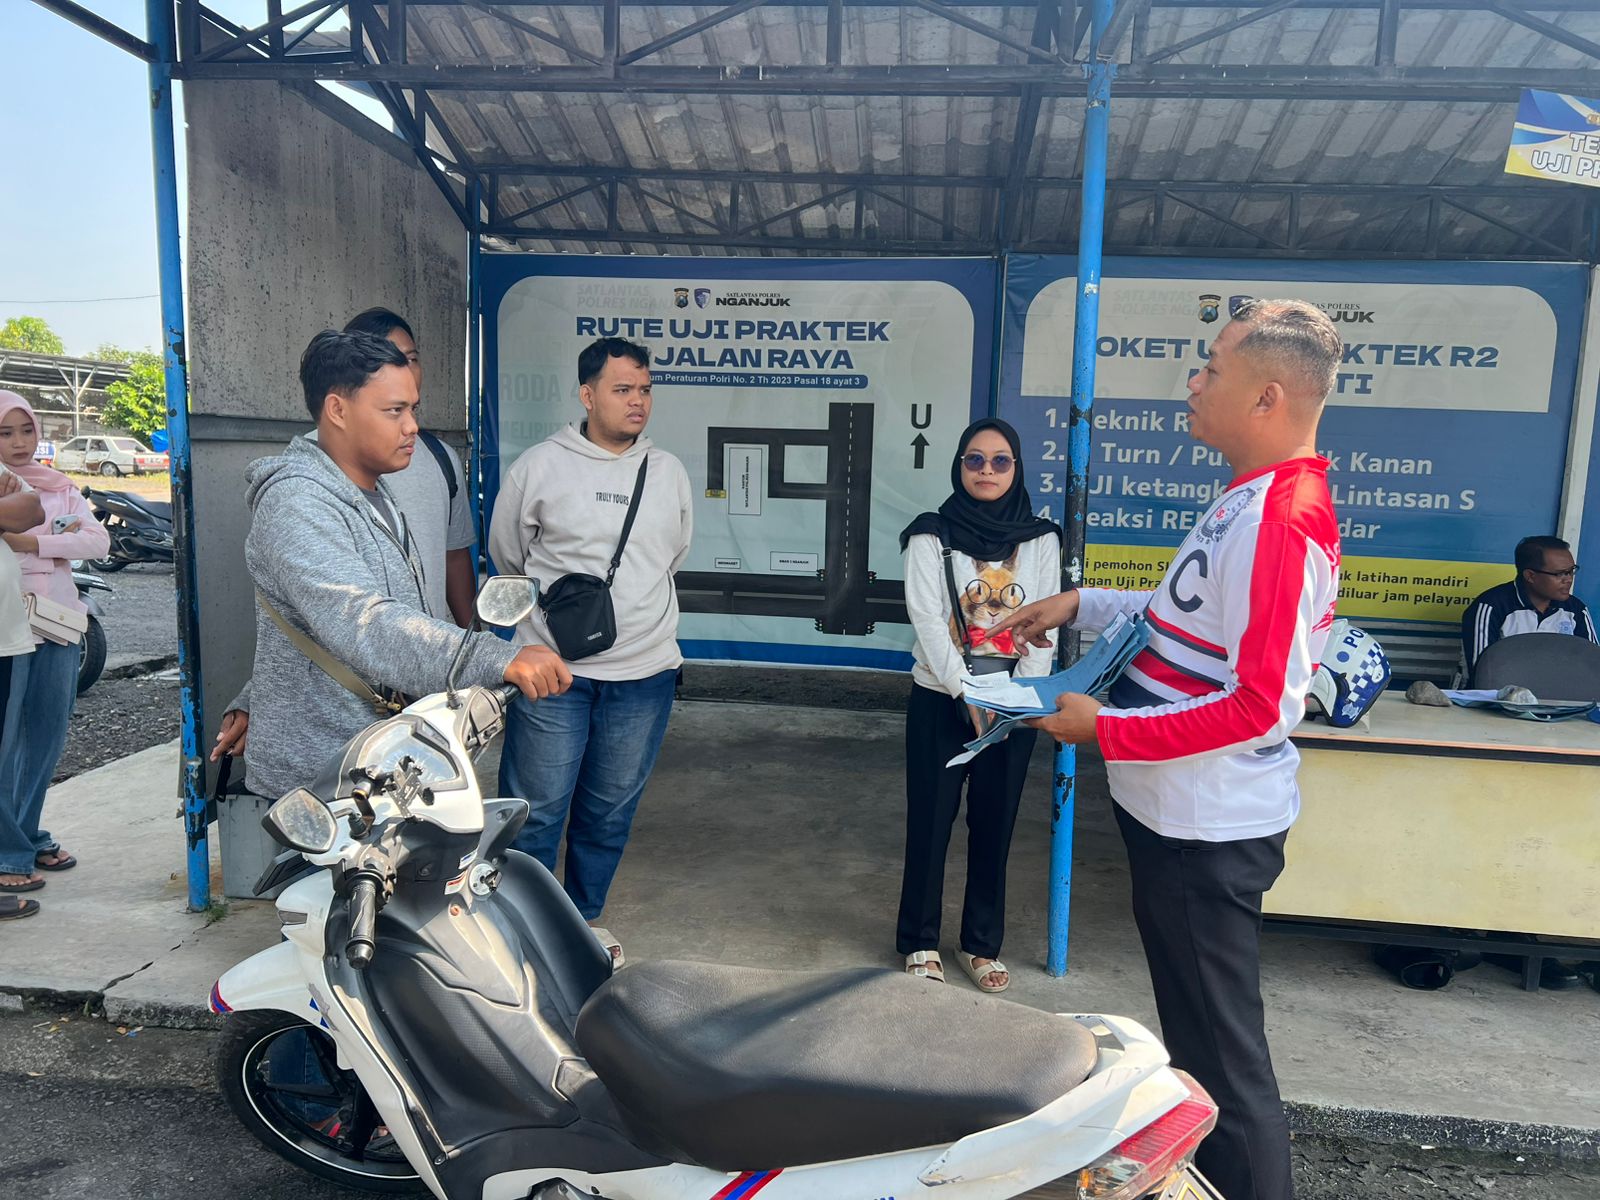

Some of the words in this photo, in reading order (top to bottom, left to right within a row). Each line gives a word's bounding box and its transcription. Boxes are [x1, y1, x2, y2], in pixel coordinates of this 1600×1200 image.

[1569, 132, 1600, 156] TE
[1531, 149, 1571, 174] UJI
[716, 298, 791, 307] NGANJUK
[576, 316, 664, 338] RUTE
[669, 320, 729, 340] UJI
[735, 320, 891, 342] PRAKTEK
[654, 346, 762, 368] JALAN
[768, 349, 854, 370] RAYA
[1096, 336, 1191, 359] OKET
[1342, 343, 1444, 367] KTEK
[1449, 346, 1499, 368] R2
[664, 374, 707, 382] Peraturan
[710, 375, 731, 383] Polri
[733, 375, 748, 384] No.
[750, 376, 755, 384] 2
[758, 376, 769, 384] Th
[771, 376, 792, 385] 2023
[794, 376, 818, 385] Pasal
[822, 377, 831, 385] 18
[833, 378, 852, 387] ayat
[855, 378, 860, 386] 3
[911, 403, 932, 430] U
[1045, 408, 1068, 429] 1.
[1093, 409, 1166, 432] eknik
[1041, 441, 1065, 461] 2.
[1101, 442, 1161, 464] Turn
[1168, 445, 1184, 466] /
[1350, 452, 1432, 475] Kanan
[596, 492, 612, 503] TRULY
[613, 493, 629, 506] YOURS
[1039, 473, 1063, 493] 3.
[1089, 475, 1113, 495] JI
[1121, 476, 1227, 505] ketangk
[1331, 484, 1450, 509] Lintasan
[1459, 489, 1476, 511] S
[1086, 507, 1153, 529] eaksi
[1338, 518, 1381, 539] dar
[1093, 559, 1153, 571] pemohon
[1338, 570, 1351, 581] uk
[1357, 571, 1408, 584] latihan
[1412, 574, 1469, 588] mandiri
[1083, 577, 1112, 590] ngan
[1116, 576, 1135, 589] Uji
[1139, 577, 1162, 588] Pra
[1337, 587, 1379, 600] diluar
[1382, 589, 1410, 603] jam
[1414, 592, 1476, 606] pelayan
[1343, 629, 1367, 649] PO
